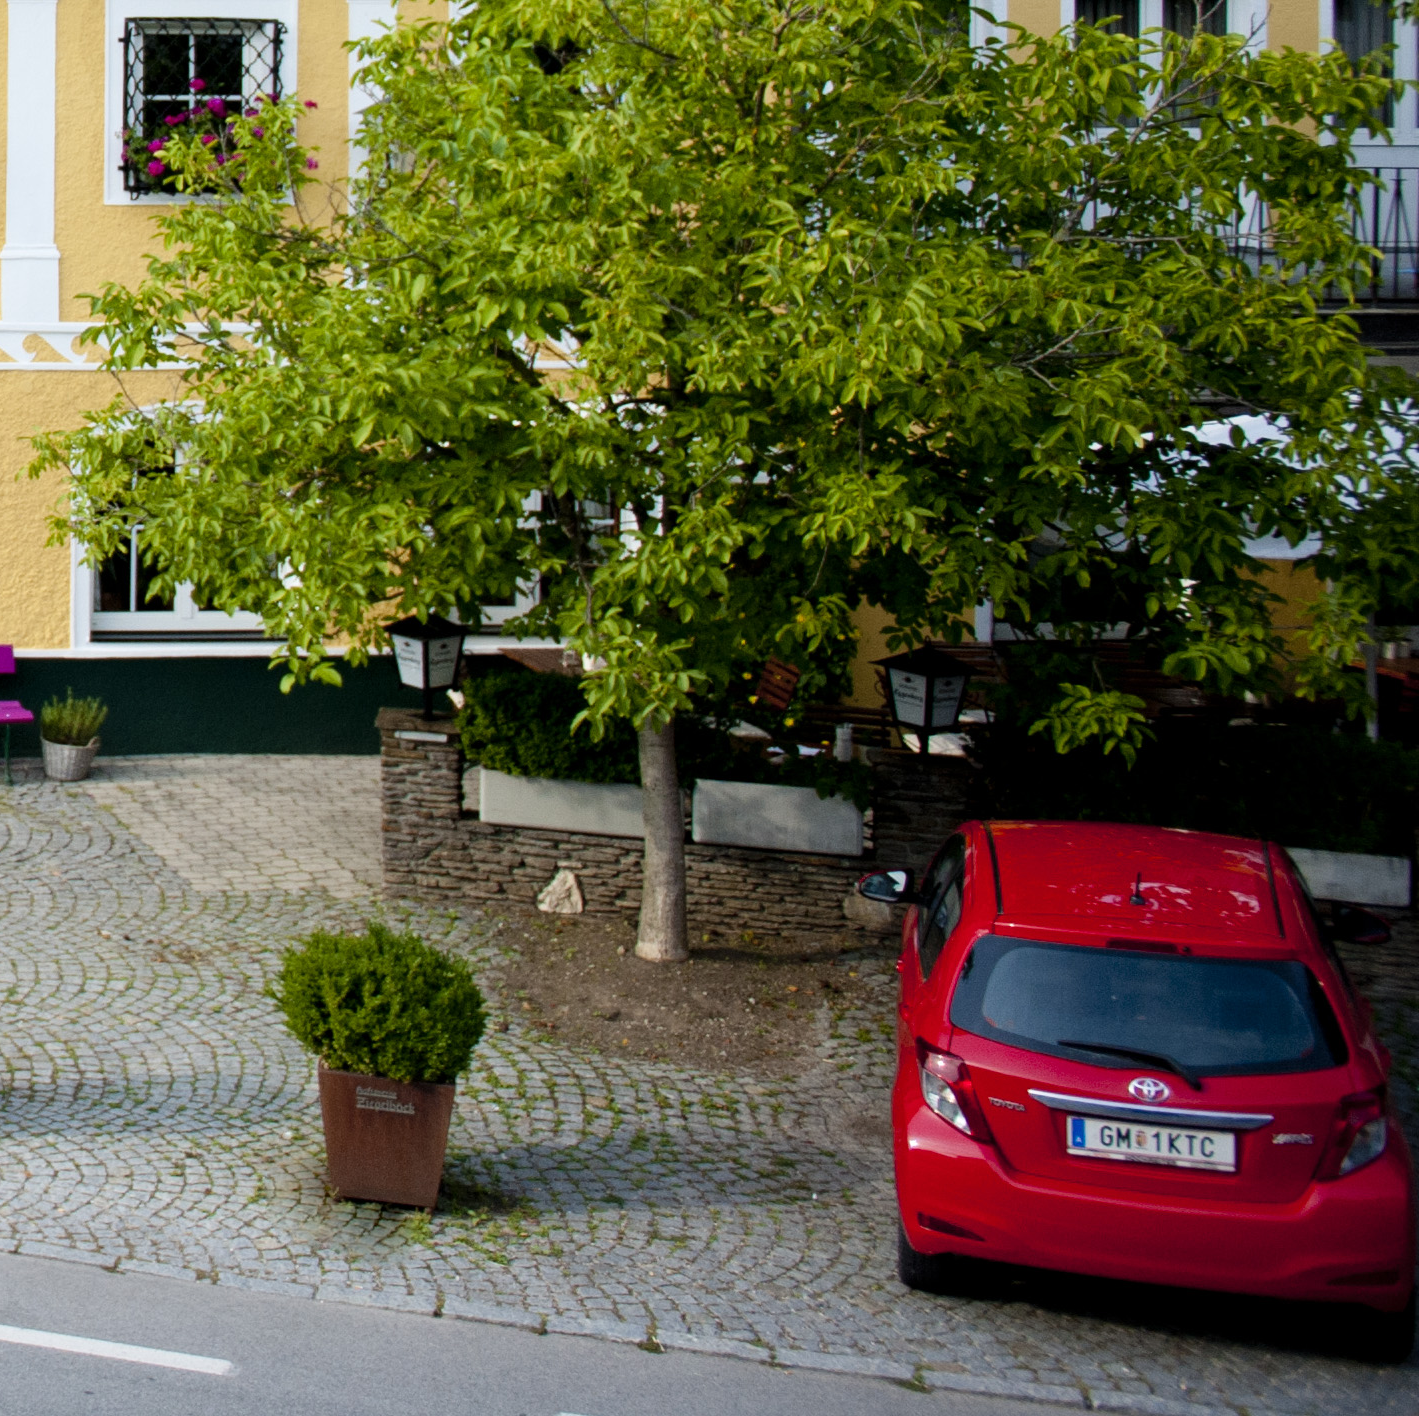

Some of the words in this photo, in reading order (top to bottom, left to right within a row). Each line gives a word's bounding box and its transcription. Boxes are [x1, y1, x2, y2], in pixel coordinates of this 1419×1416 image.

[988, 1096, 1026, 1111] TOYOTA
[1100, 1126, 1131, 1149] GM
[1152, 1132, 1213, 1158] 1KTC
